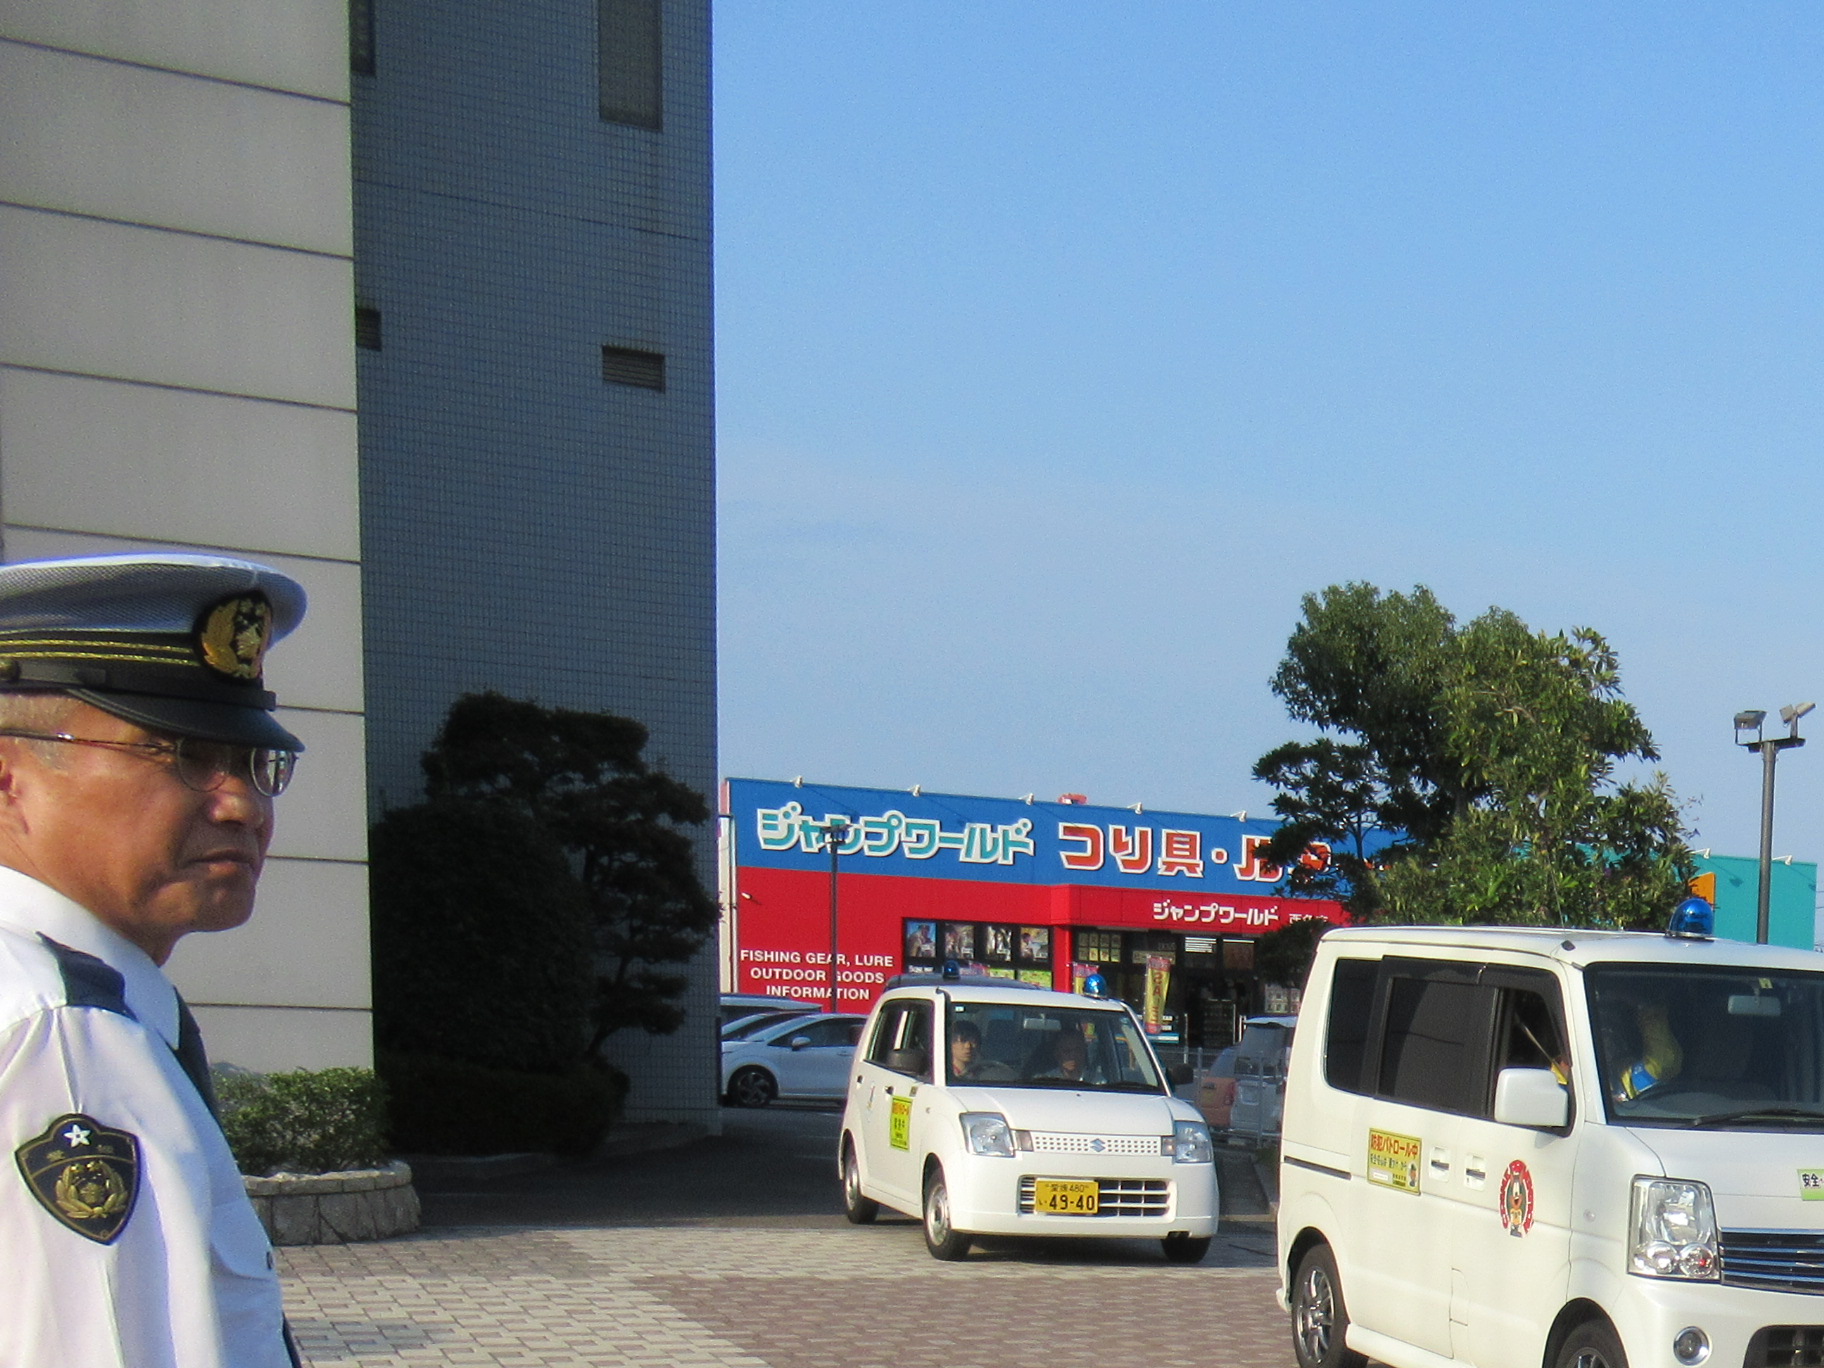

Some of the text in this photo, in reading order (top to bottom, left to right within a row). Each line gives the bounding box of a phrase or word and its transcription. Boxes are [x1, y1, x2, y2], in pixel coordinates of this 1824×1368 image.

[757, 801, 1034, 865] ジャンプワールド
[1153, 899, 1279, 926] ジャンプワールド
[740, 949, 801, 963] FISHING
[855, 954, 894, 967] LURE
[750, 967, 826, 981] OUTDOOR
[766, 985, 870, 1000] INFORMATION
[1049, 1194, 1095, 1211] 49-40
